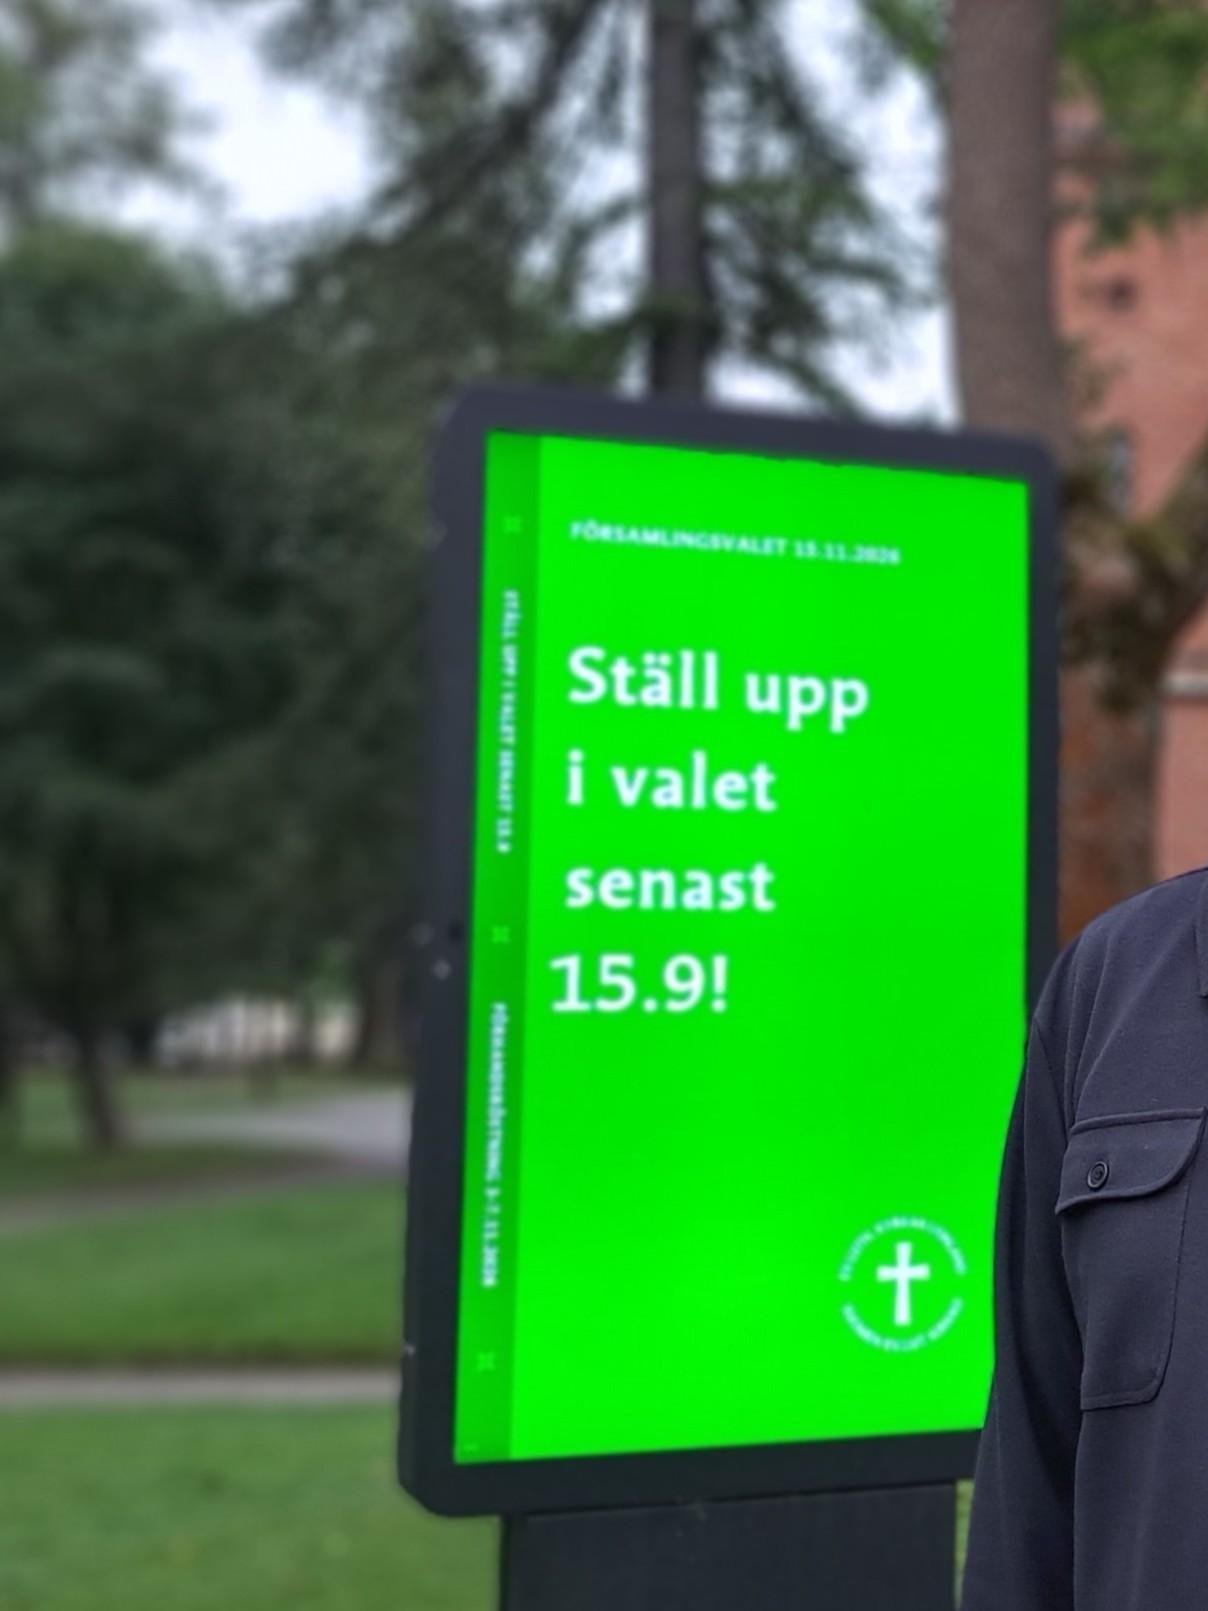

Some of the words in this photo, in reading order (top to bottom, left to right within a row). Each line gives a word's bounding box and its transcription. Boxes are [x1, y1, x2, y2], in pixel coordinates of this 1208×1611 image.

[570, 519, 787, 556] FÖRSAMLINGSVALET
[568, 645, 718, 710] Ställ
[745, 673, 869, 733] upp
[567, 748, 584, 805] i
[610, 749, 776, 812] valet
[565, 862, 775, 912] senast
[550, 953, 728, 1012] 15.9!
